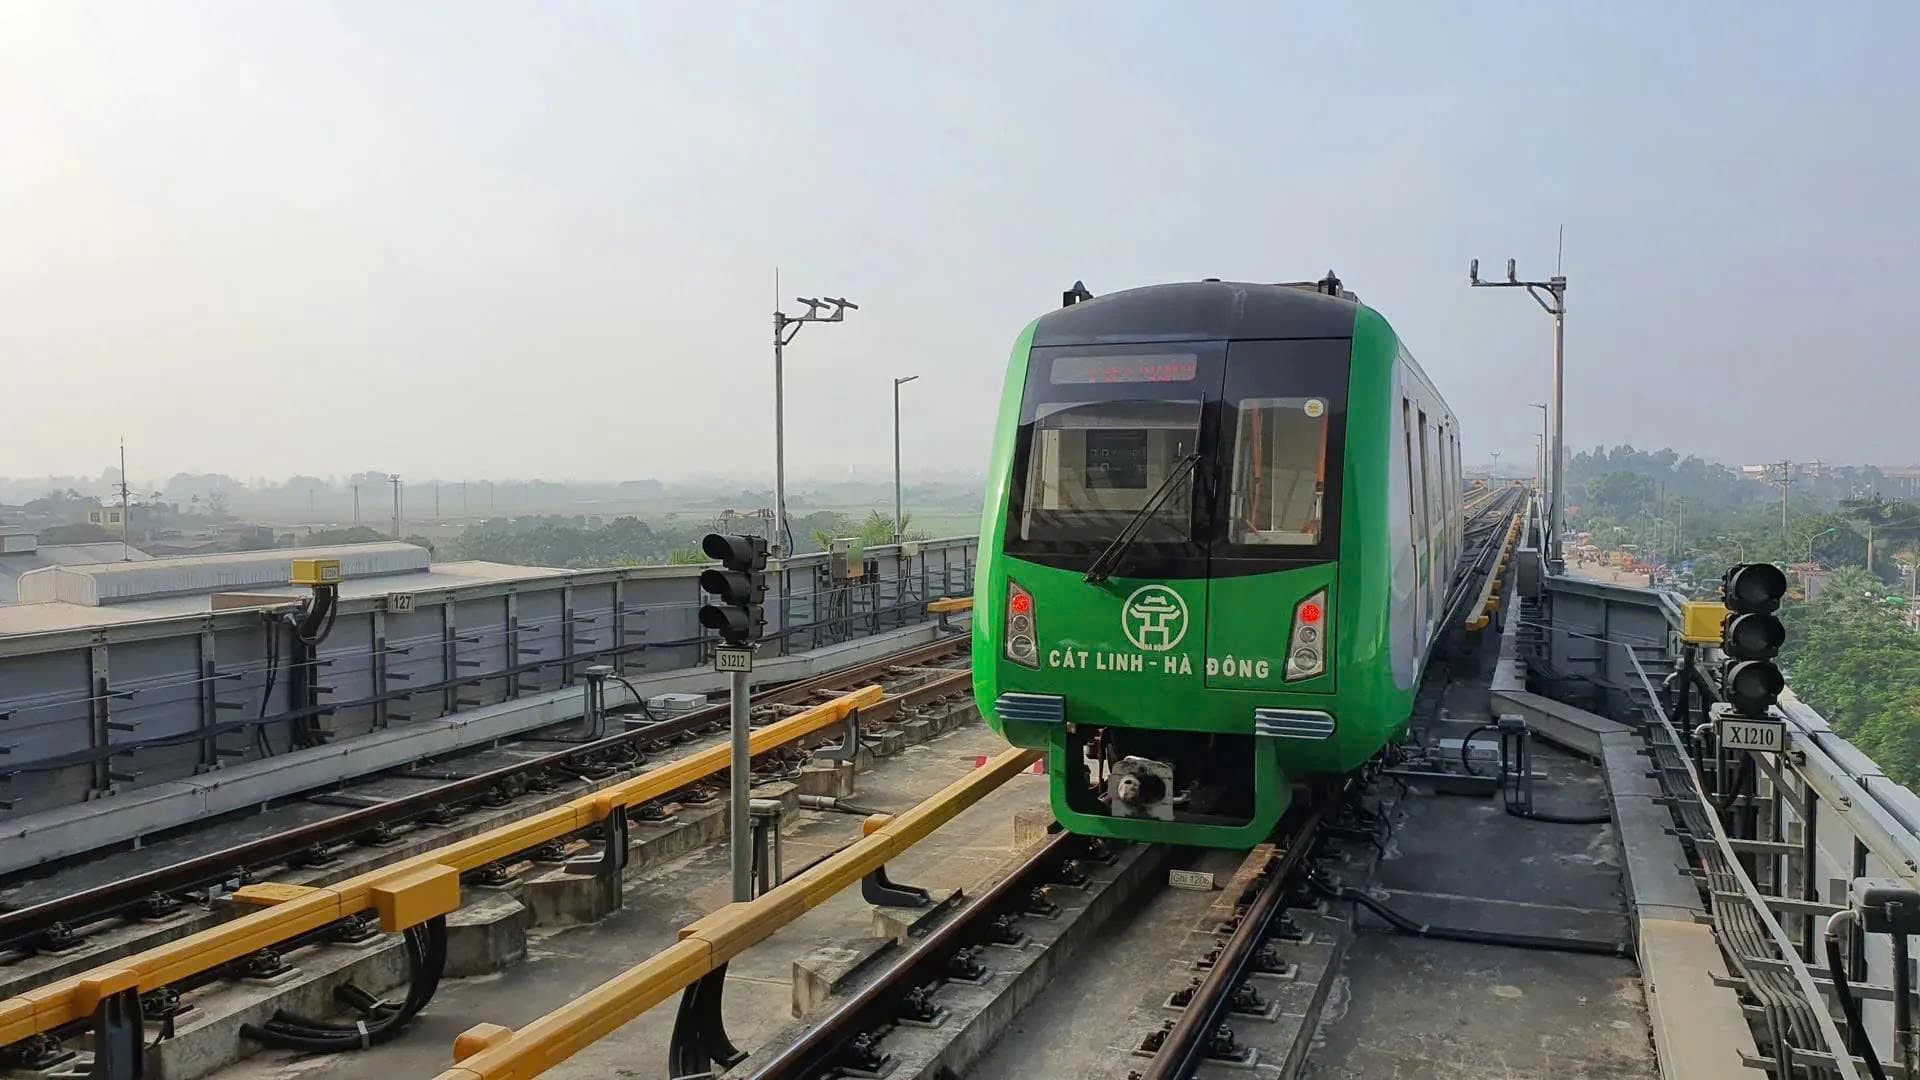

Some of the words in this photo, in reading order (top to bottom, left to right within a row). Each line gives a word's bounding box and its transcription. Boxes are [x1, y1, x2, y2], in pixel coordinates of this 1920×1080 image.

[393, 595, 411, 610] 127
[721, 654, 745, 668] S1212
[1049, 646, 1089, 668] CÁT
[1096, 652, 1143, 672] LINH
[1164, 652, 1193, 675] HÀ
[1206, 654, 1270, 679] ĐÔNG
[1729, 726, 1774, 746] X1210
